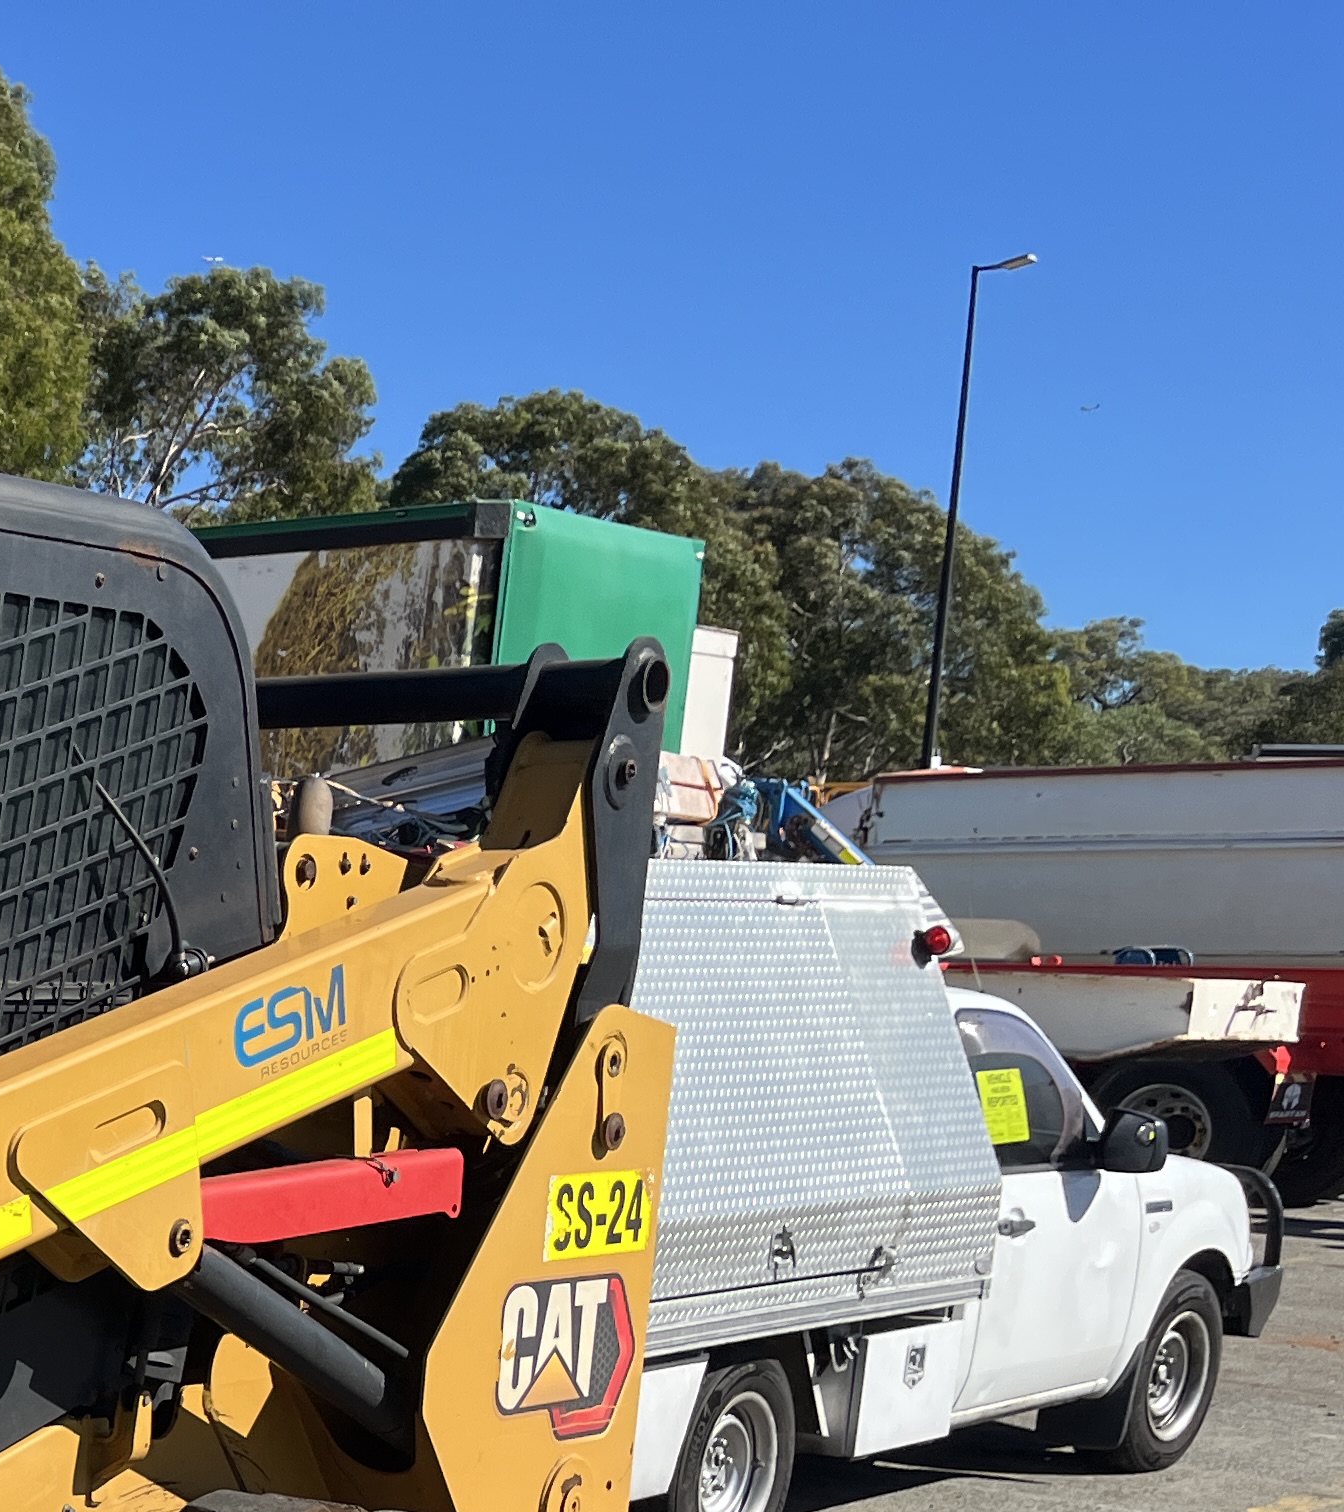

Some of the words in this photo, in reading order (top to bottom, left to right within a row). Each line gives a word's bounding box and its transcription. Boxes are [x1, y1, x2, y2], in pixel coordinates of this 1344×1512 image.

[234, 964, 346, 1068] ESM
[260, 1029, 348, 1080] RESOURCES
[553, 1179, 644, 1252] SS-24
[497, 1278, 610, 1411] CAT
